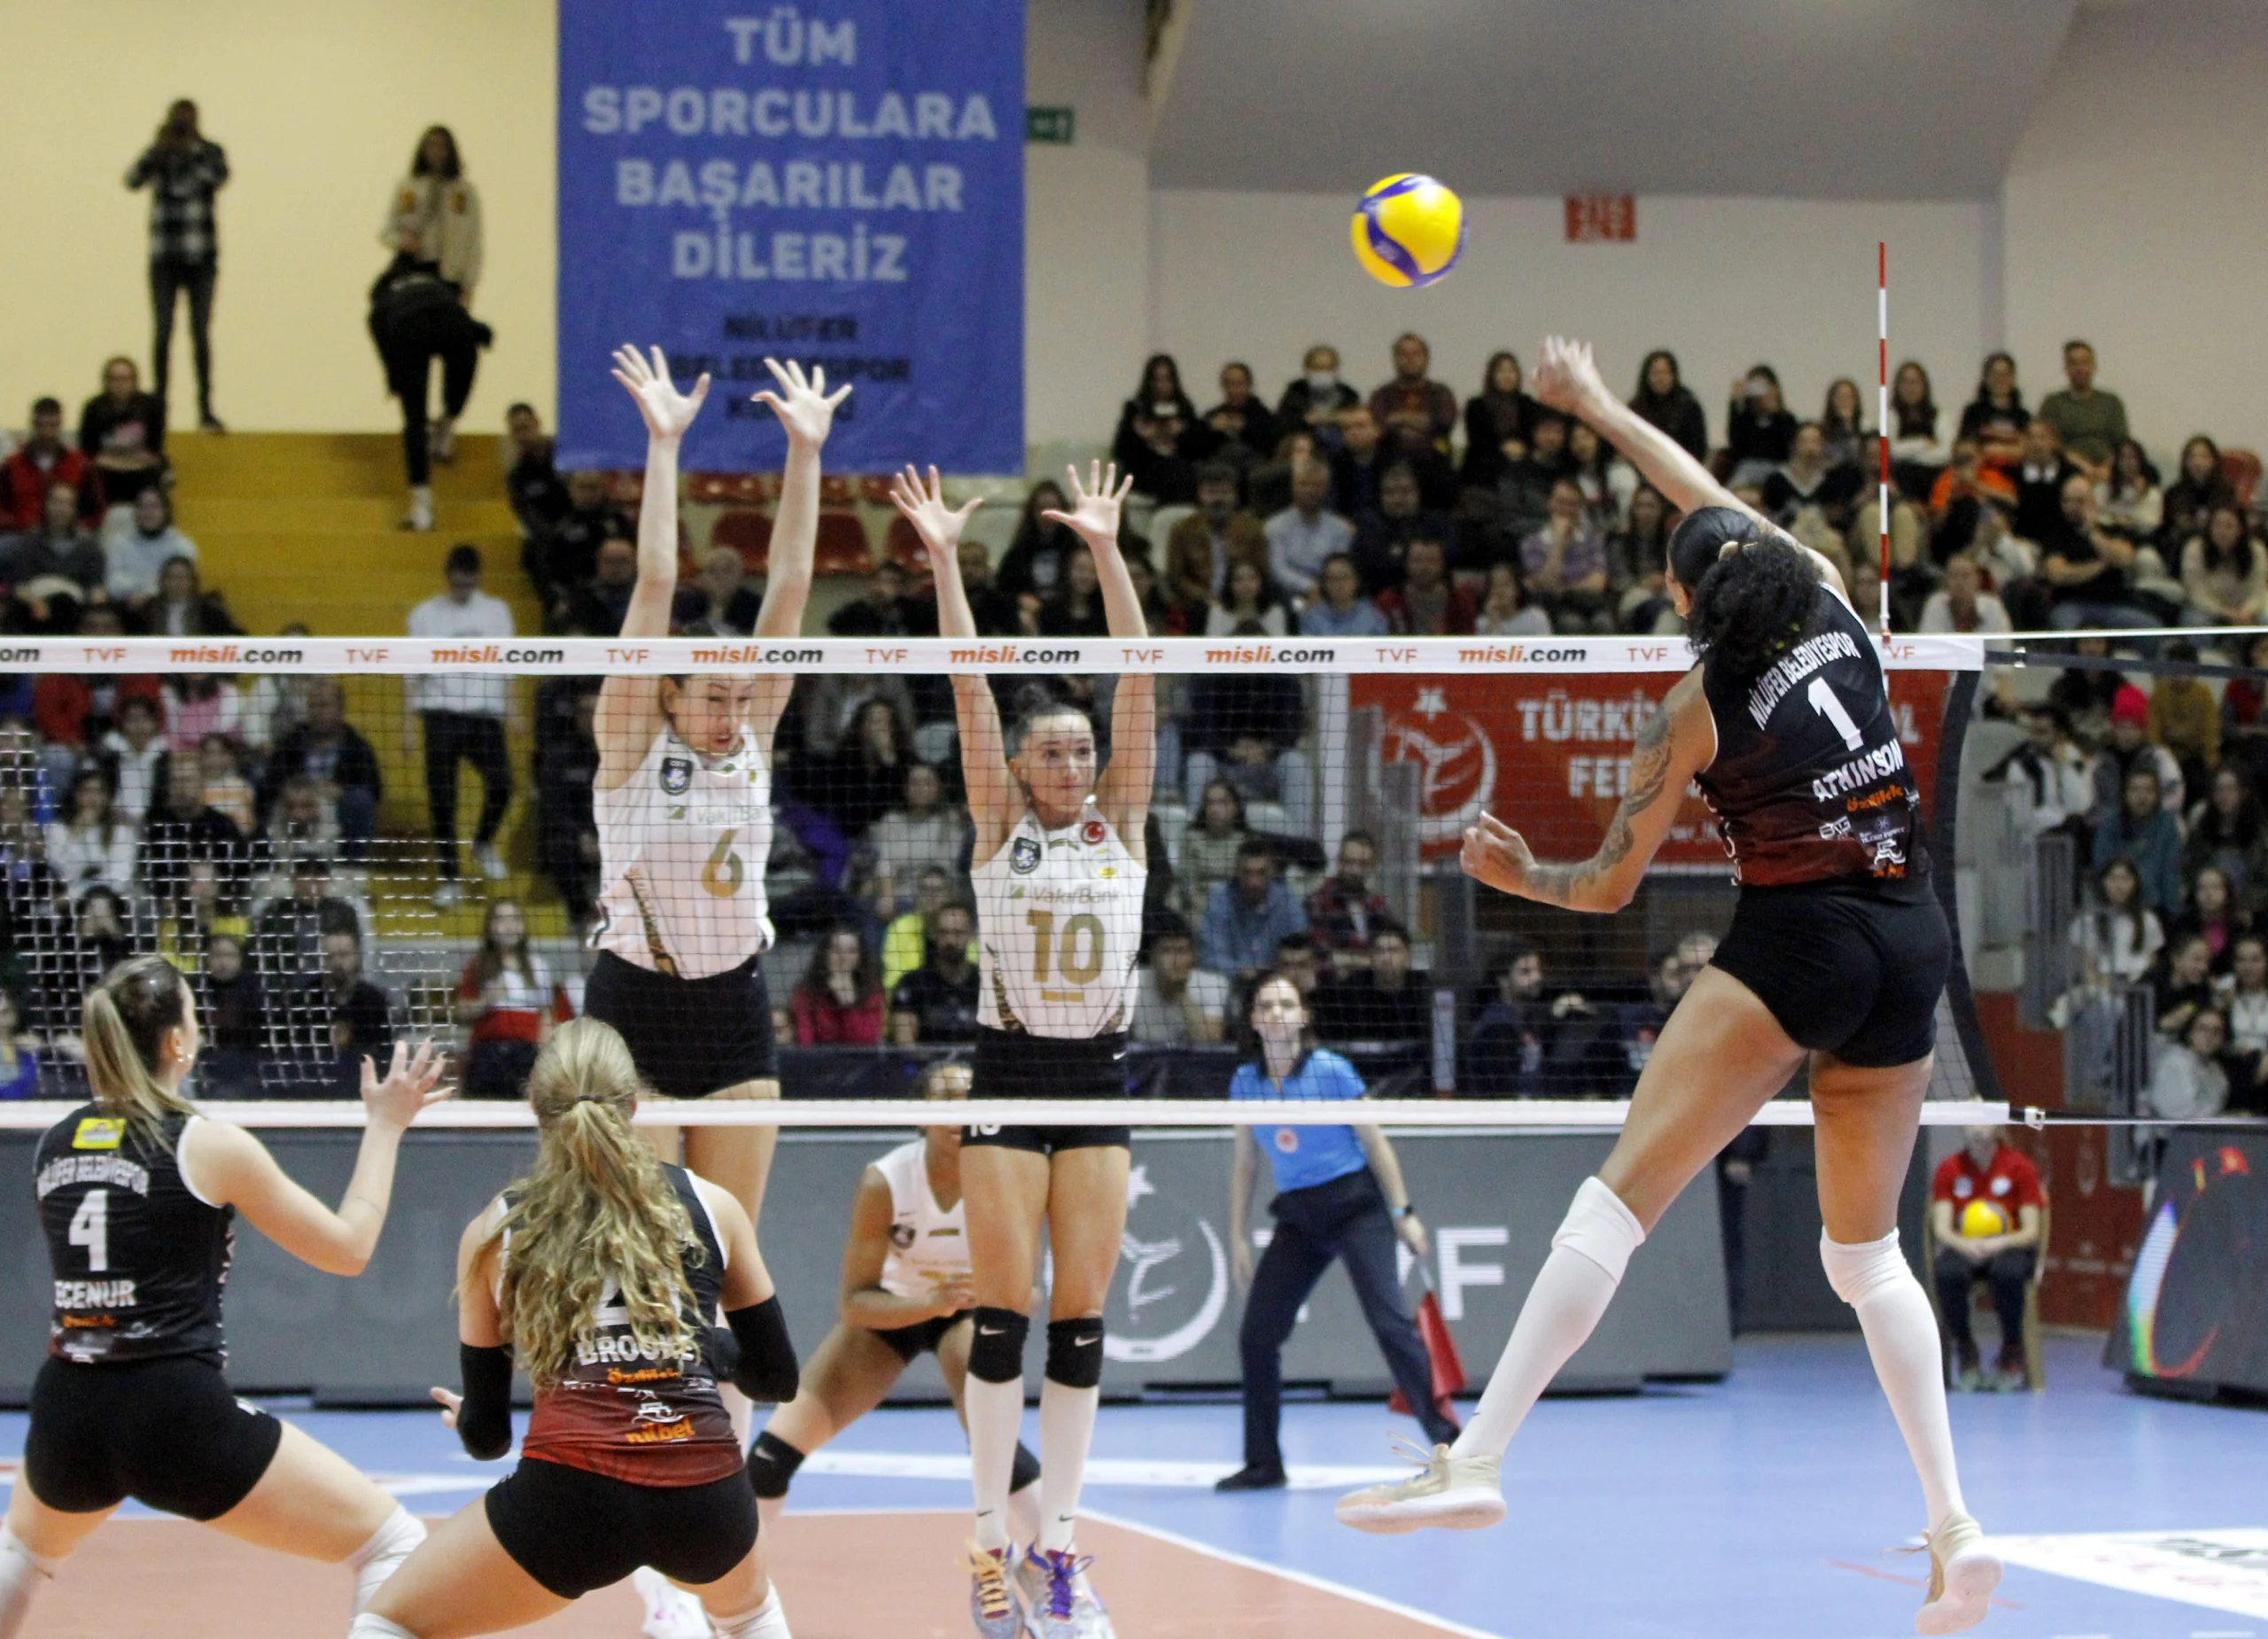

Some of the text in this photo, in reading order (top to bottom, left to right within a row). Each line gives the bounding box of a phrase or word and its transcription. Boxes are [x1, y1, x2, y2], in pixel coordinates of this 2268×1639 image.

[726, 8, 857, 66] TÜM
[583, 86, 998, 140] SPORCULARA
[615, 159, 964, 221] BAŞARILAR
[672, 217, 909, 282] DİLERİZ
[82, 648, 127, 663] TVF
[168, 645, 303, 664] misli.com
[346, 648, 388, 663] TVF
[431, 645, 564, 664] misli.com
[606, 648, 649, 663] TVF
[691, 645, 824, 664] misli.com
[864, 648, 907, 663] TVF
[949, 645, 1081, 664] misli.com
[1122, 649, 1163, 664] TVF
[1205, 645, 1335, 664] misli.com
[1376, 648, 1417, 663] TVF
[1457, 645, 1587, 663] misli.com
[1627, 647, 1667, 661] TVF
[1518, 689, 1658, 742] TÜRKİ
[1808, 677, 1864, 751] 1
[1813, 738, 1904, 803] ATKINSON
[701, 829, 743, 898] 6
[1026, 909, 1105, 985] 10
[68, 1190, 108, 1271] 4
